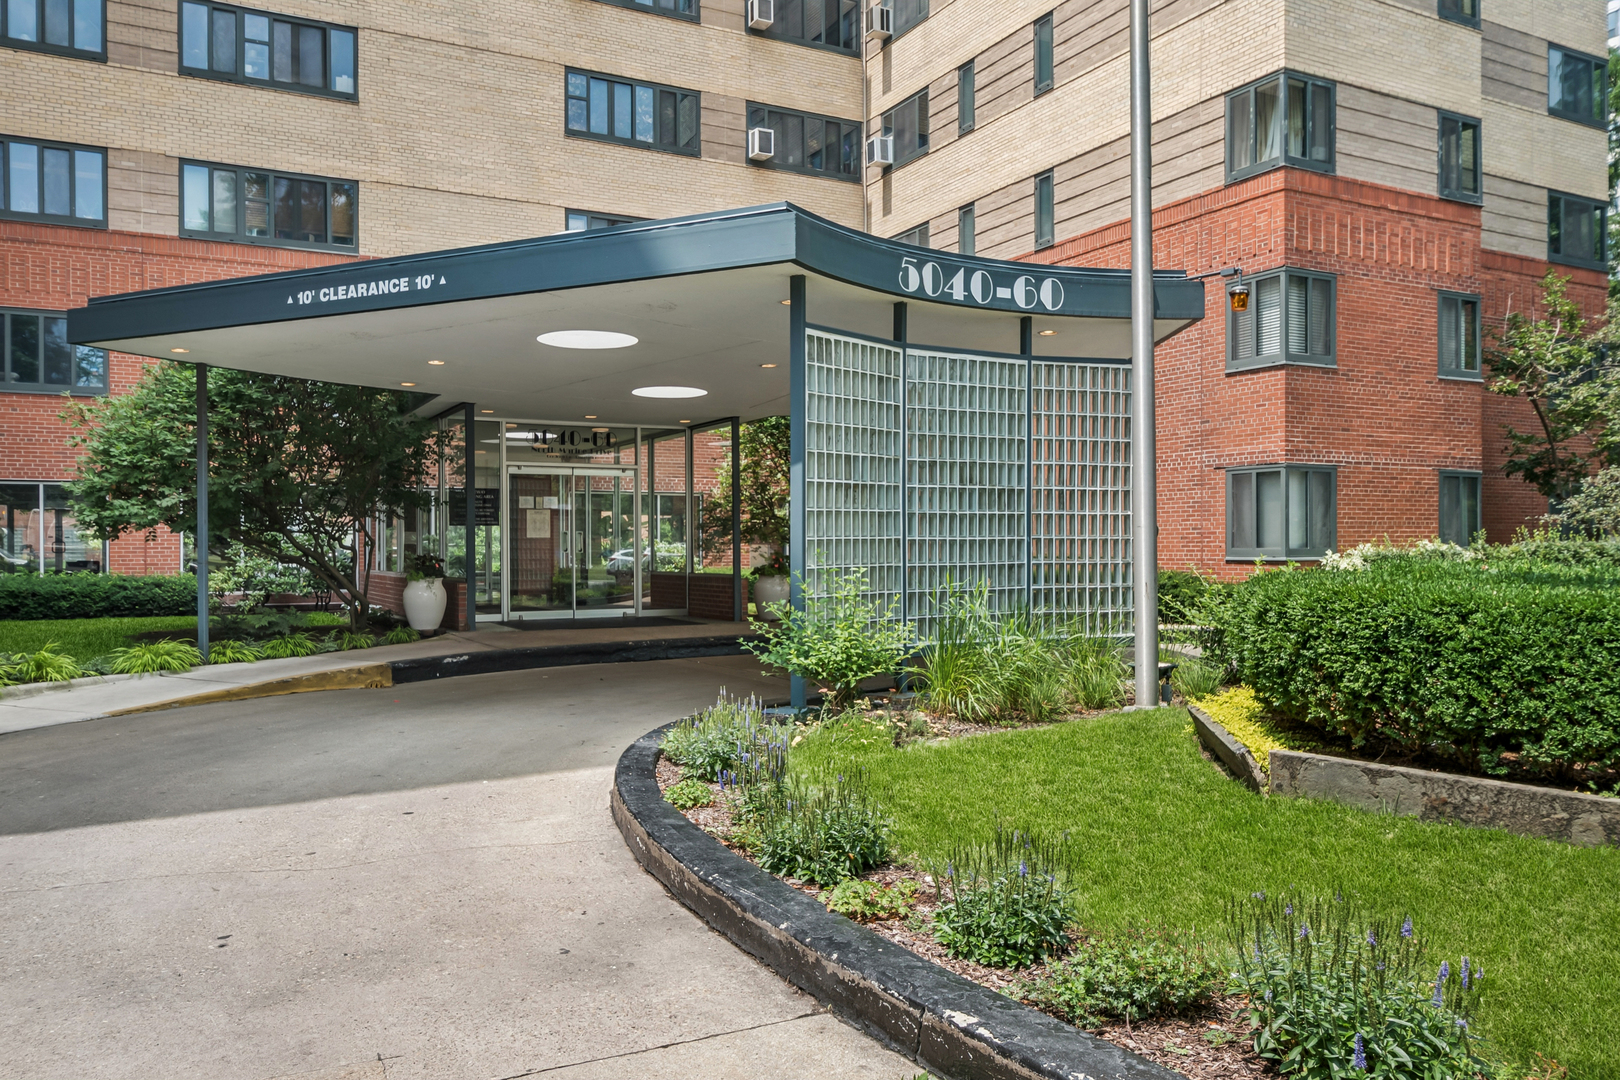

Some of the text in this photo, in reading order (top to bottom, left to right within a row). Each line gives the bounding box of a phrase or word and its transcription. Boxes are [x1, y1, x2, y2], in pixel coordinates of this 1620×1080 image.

[297, 274, 435, 305] 10' CLEARANCE 10'
[898, 256, 1065, 311] 5040-60
[525, 429, 618, 448] 5040-60
